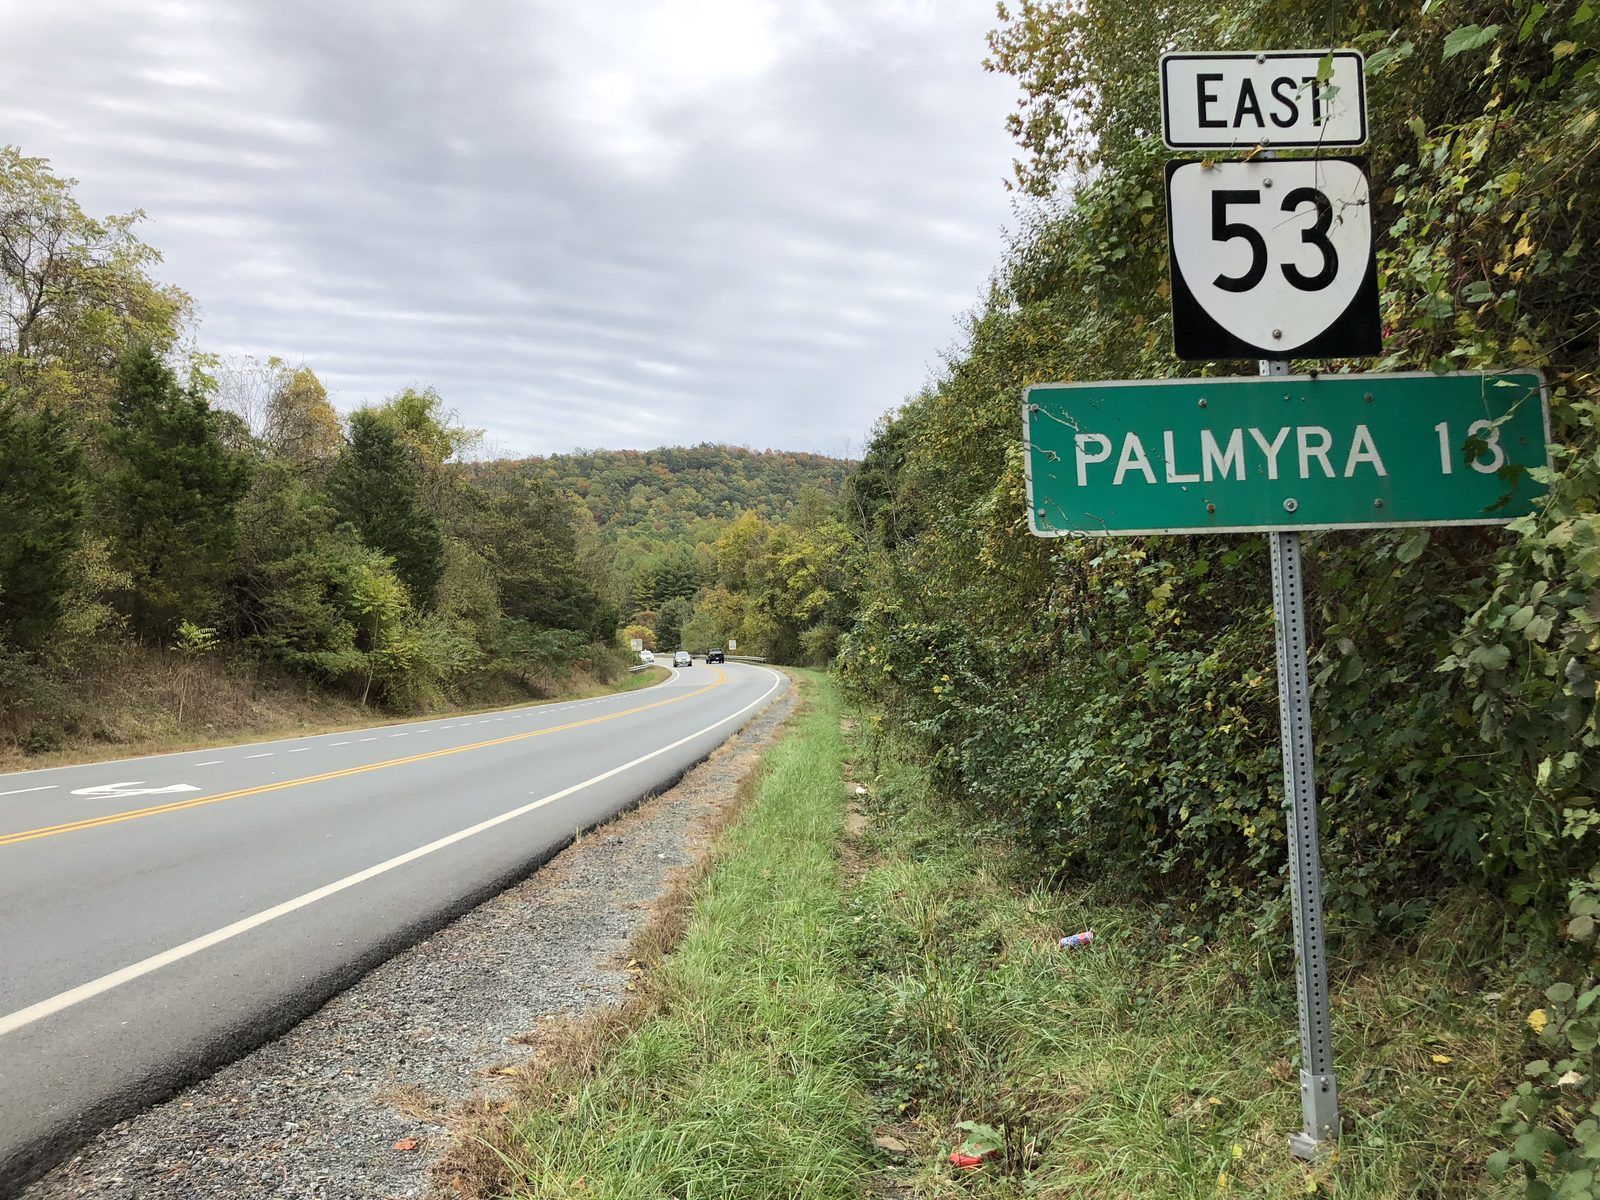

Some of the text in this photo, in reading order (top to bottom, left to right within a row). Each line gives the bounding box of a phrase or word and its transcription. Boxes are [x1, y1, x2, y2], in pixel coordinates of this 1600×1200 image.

[1196, 73, 1326, 128] EAST
[1211, 186, 1339, 293] 53
[1074, 424, 1388, 487] PALMYRA
